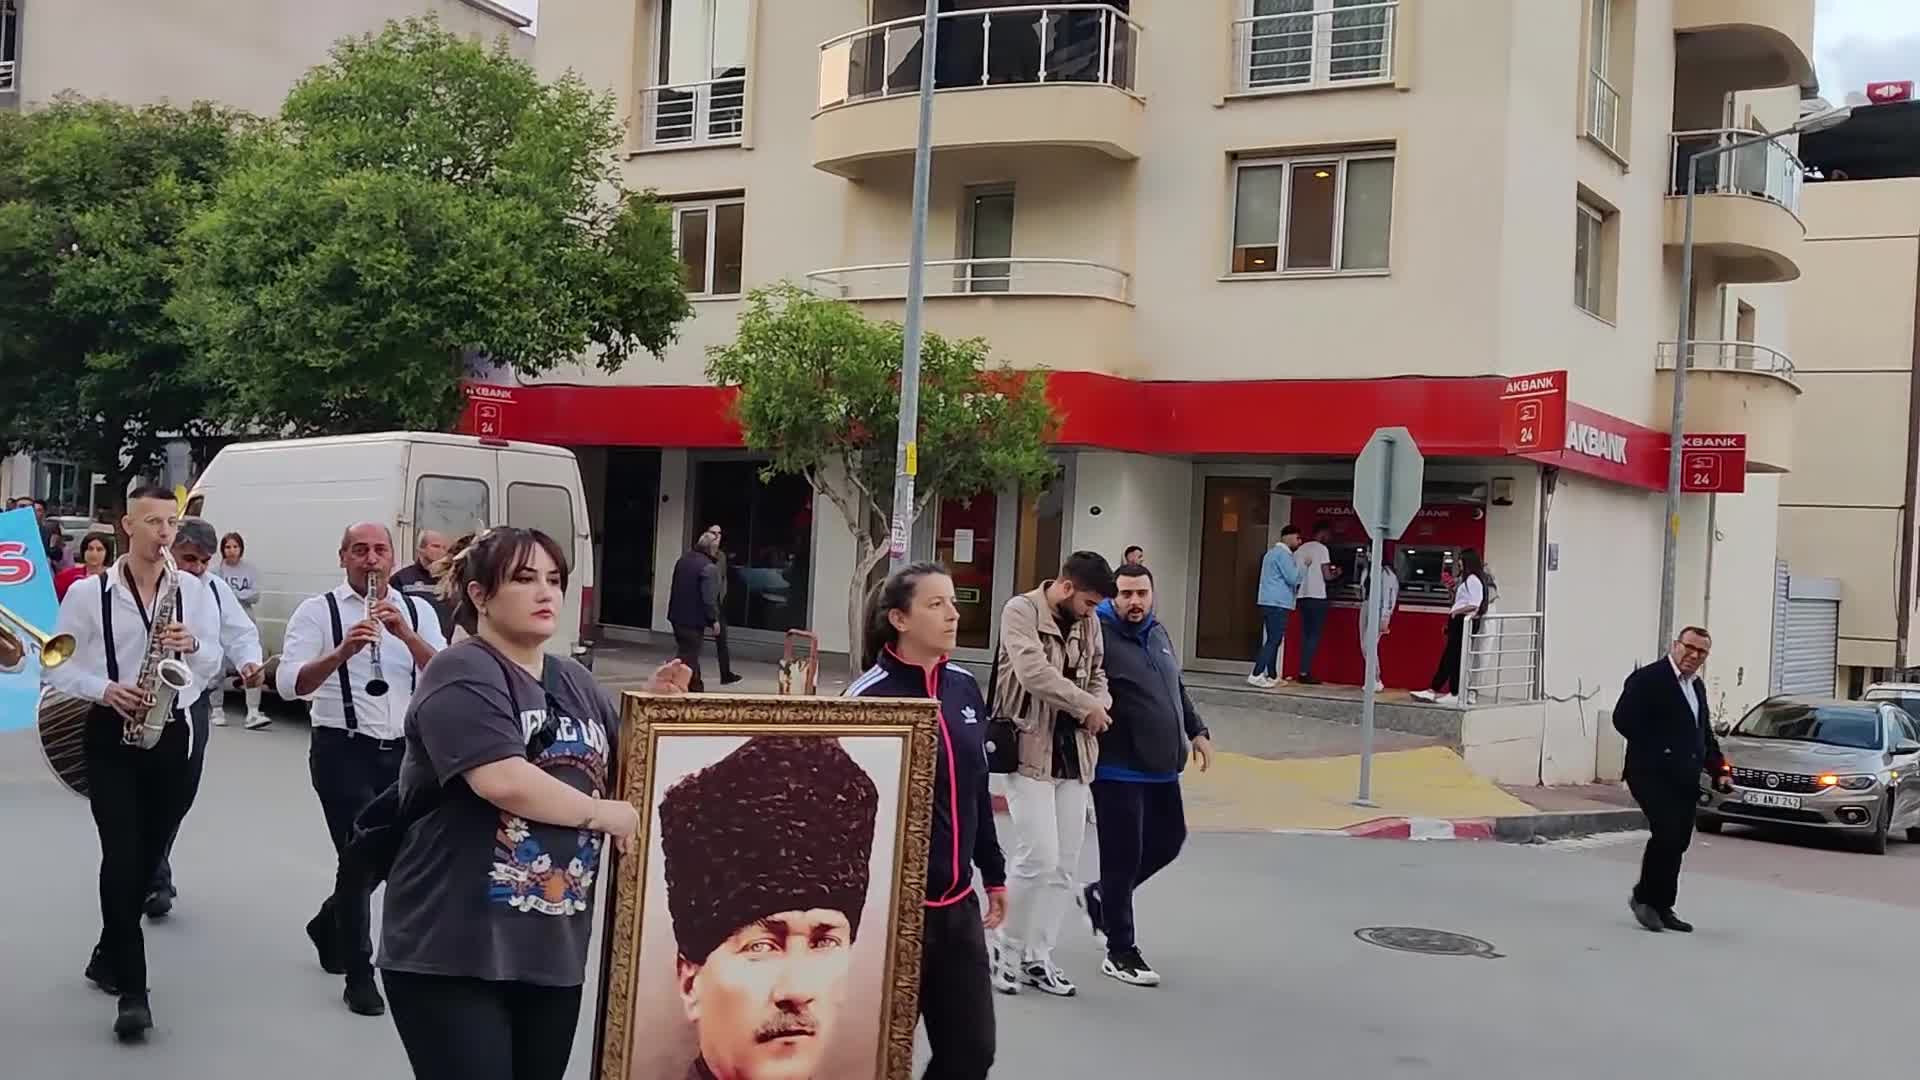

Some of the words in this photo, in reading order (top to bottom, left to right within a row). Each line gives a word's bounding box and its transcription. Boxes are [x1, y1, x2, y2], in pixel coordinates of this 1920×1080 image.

[1504, 376, 1554, 394] AKBANK
[481, 421, 494, 433] 24
[1519, 427, 1533, 442] 24
[1565, 420, 1628, 465] AKBANK
[1681, 437, 1738, 448] KBANK
[1693, 473, 1710, 486] 24
[1316, 506, 1354, 515] AKBA
